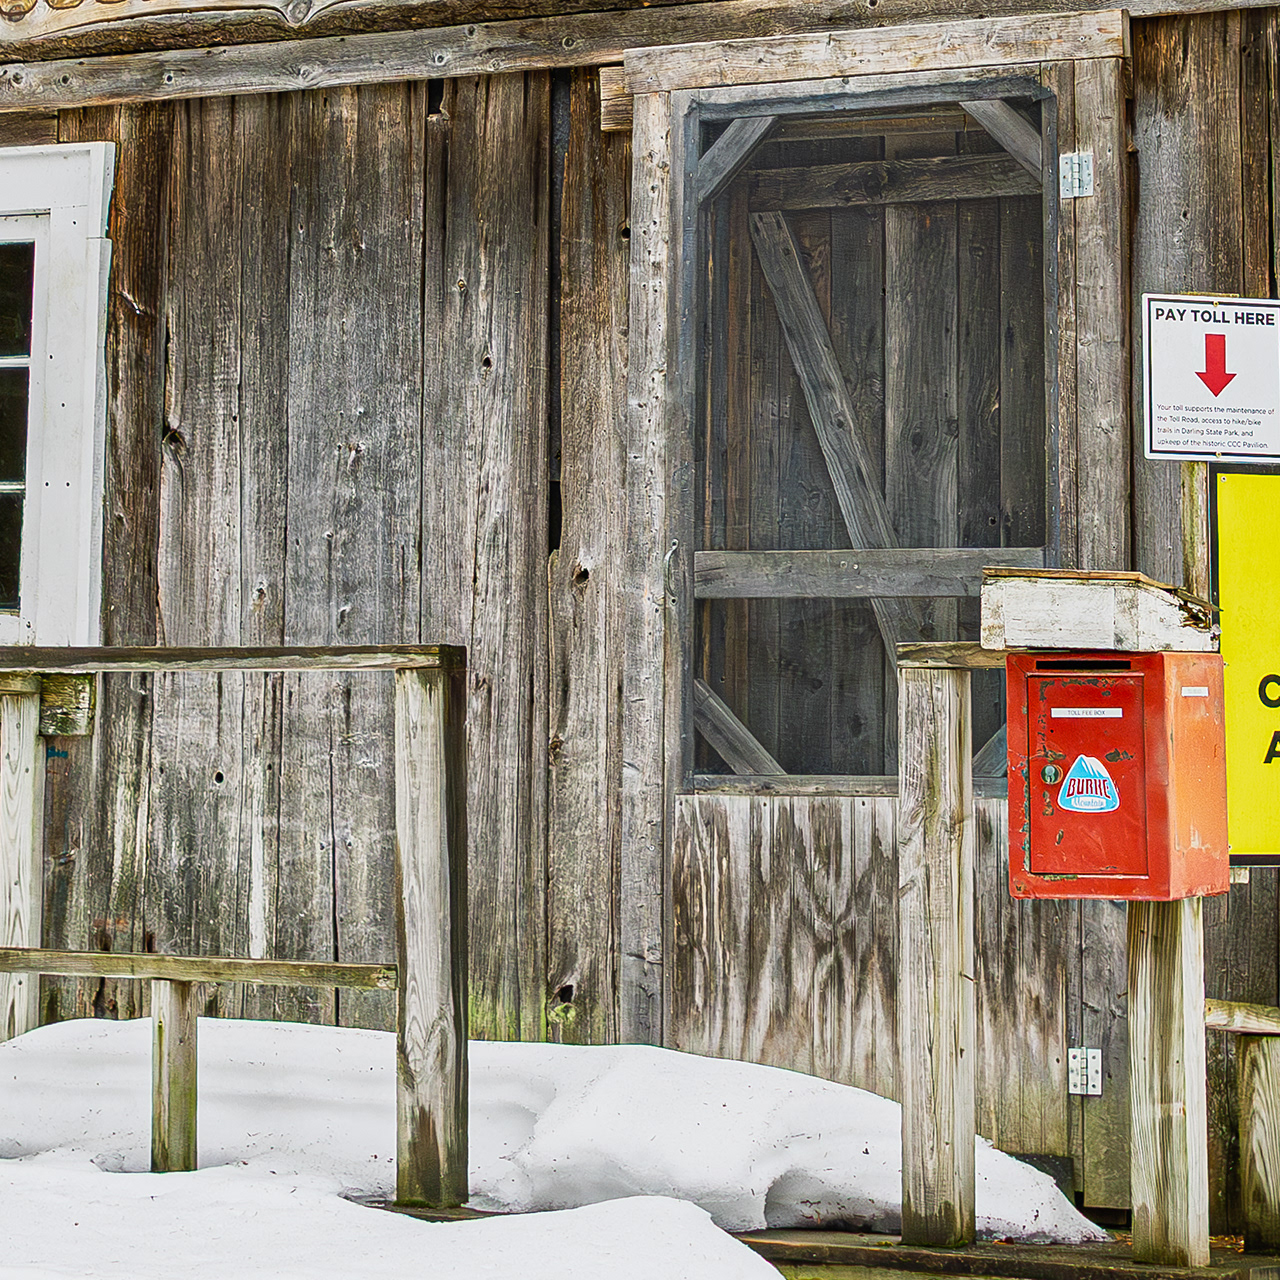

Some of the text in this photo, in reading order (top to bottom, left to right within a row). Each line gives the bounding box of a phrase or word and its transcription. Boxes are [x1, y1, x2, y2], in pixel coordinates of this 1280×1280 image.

[1156, 308, 1275, 326] PAY TOLL HERE
[1226, 407, 1266, 415] maintenance
[1232, 418, 1261, 426] hike/bike
[1181, 427, 1204, 436] Darling
[1066, 778, 1111, 799] BURKE
[1073, 797, 1104, 807] Mountain
